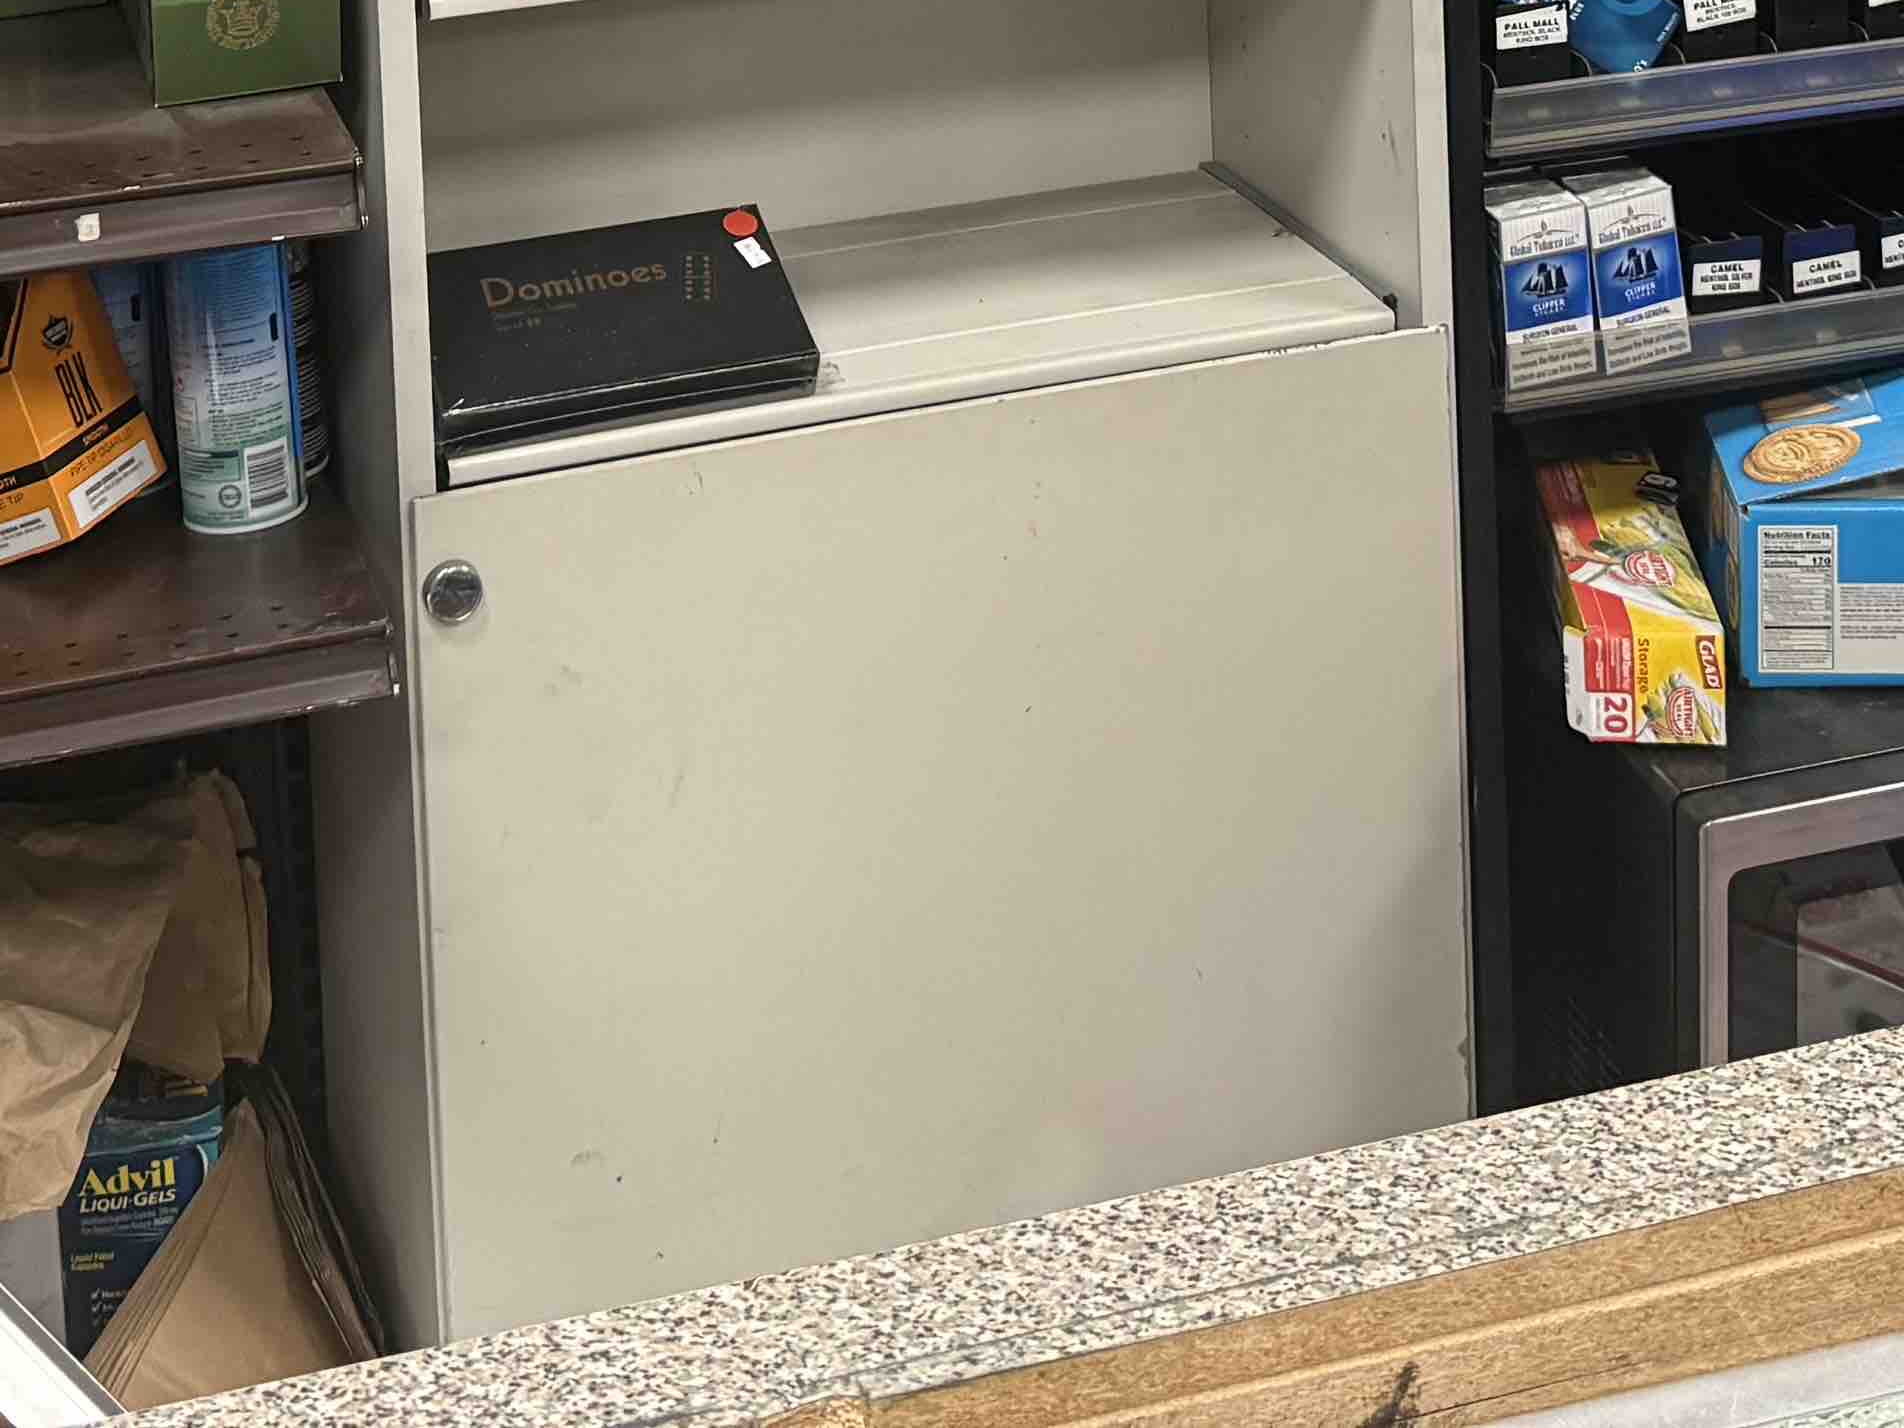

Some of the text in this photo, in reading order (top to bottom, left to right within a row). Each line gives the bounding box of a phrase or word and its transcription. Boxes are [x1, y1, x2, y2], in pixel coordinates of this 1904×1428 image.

[480, 257, 667, 308] Dominoes
[53, 356, 103, 429] BLK
[79, 1158, 175, 1199] Advil
